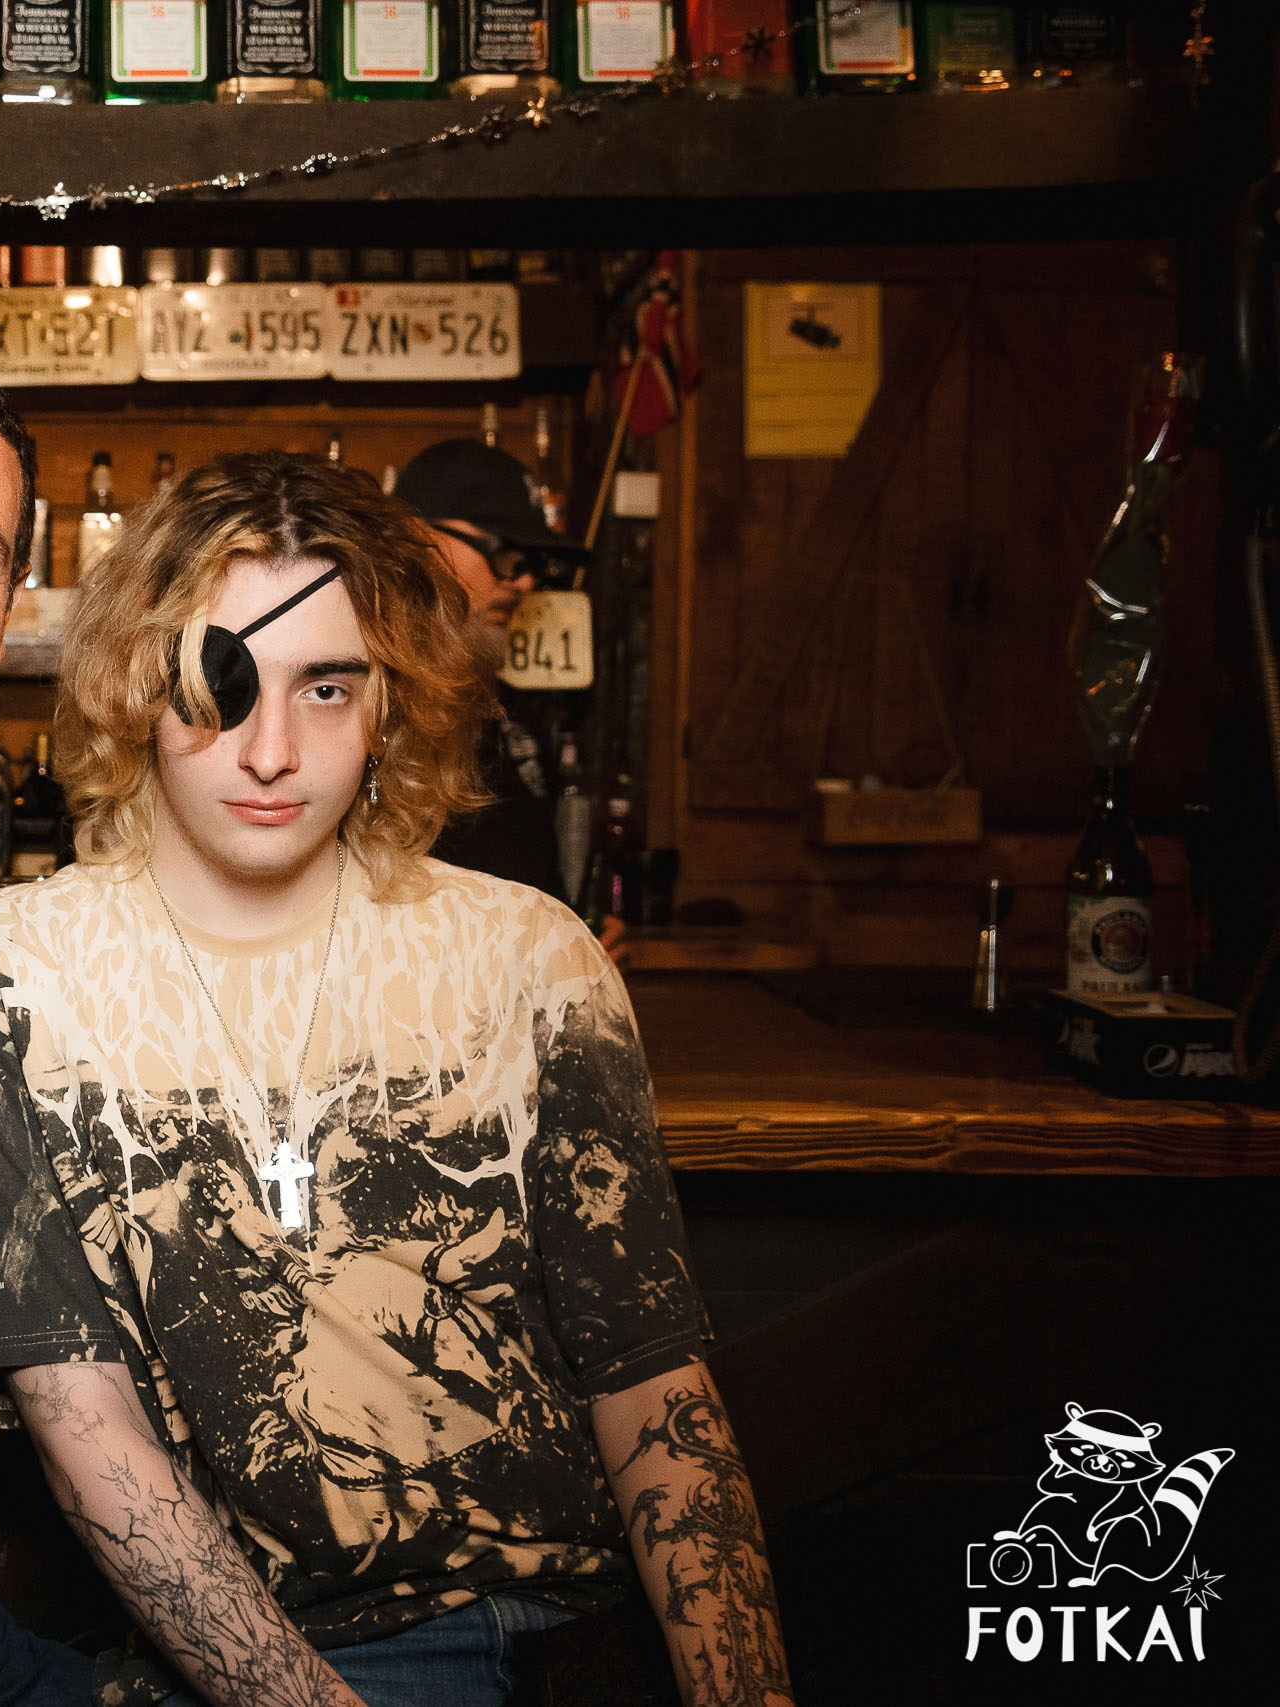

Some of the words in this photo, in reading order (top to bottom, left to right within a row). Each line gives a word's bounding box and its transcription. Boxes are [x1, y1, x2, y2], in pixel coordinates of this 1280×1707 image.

[340, 312, 410, 356] ZXN
[438, 311, 510, 356] 526
[499, 629, 578, 672] 841
